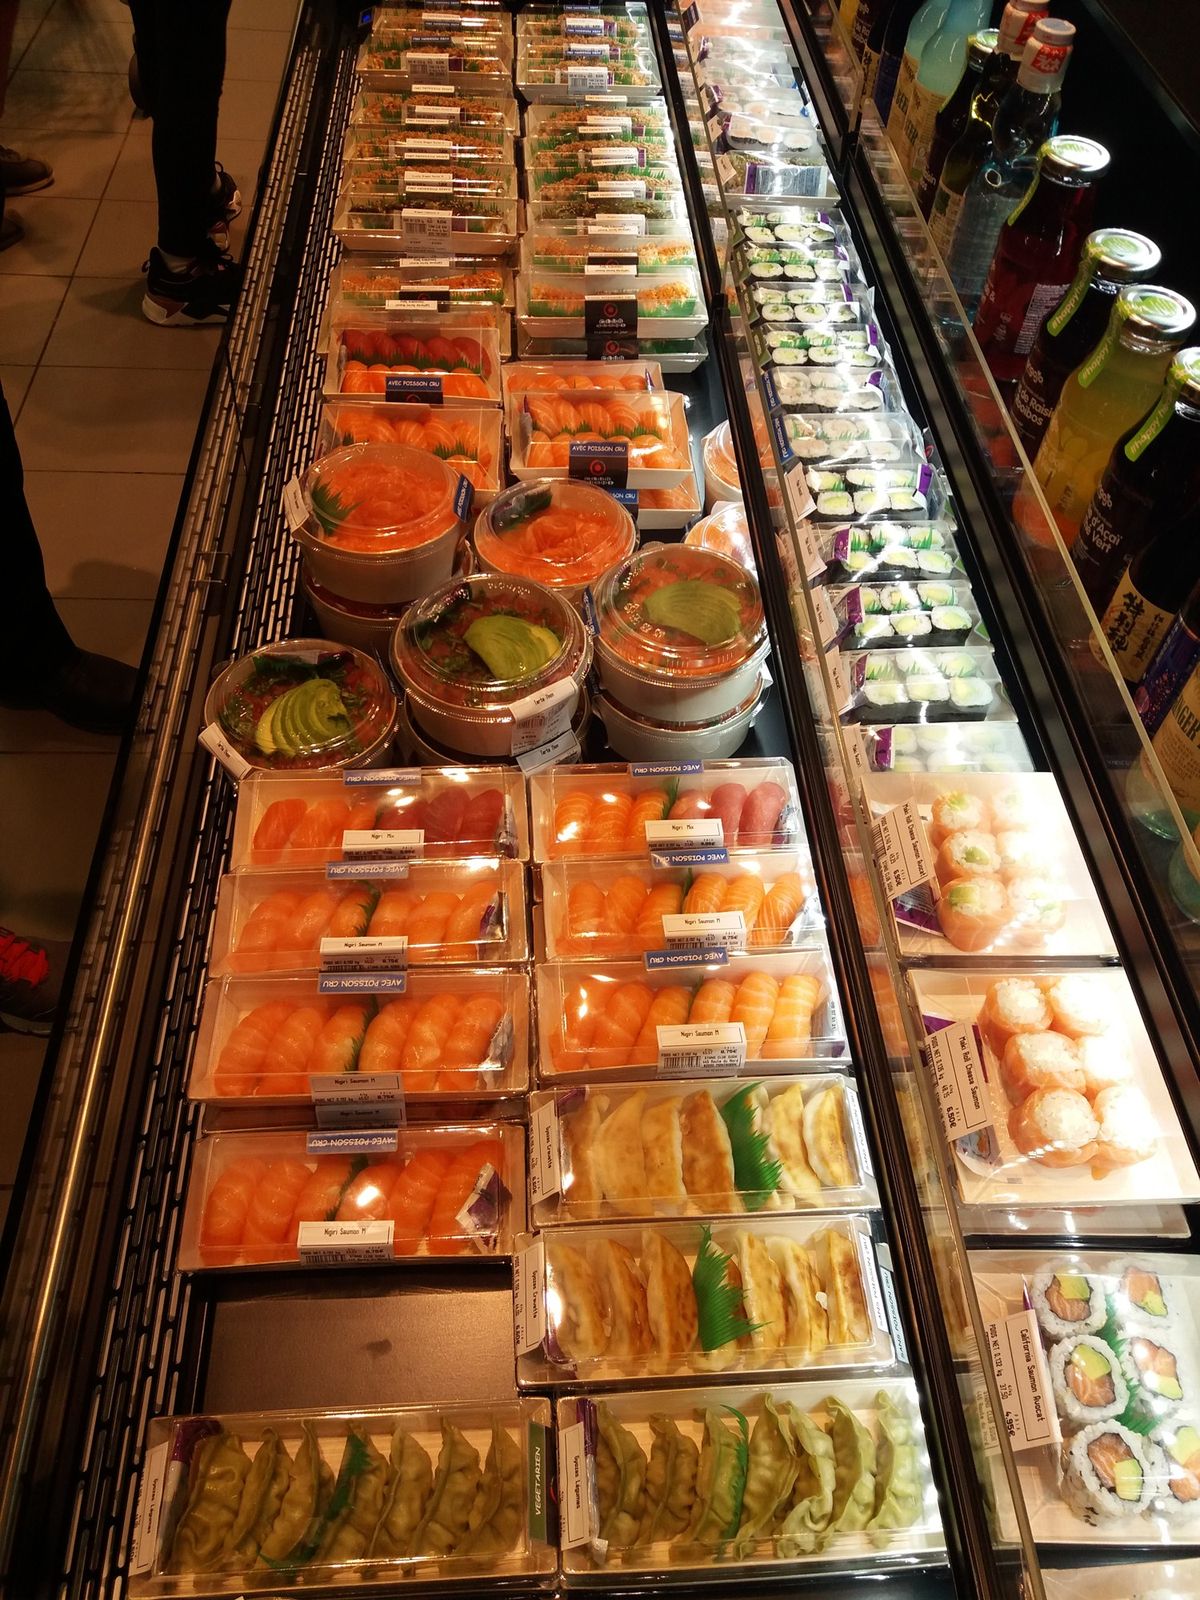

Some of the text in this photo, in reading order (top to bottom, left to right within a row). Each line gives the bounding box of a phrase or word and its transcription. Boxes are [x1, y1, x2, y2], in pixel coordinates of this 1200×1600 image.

[912, 840, 920, 859] Saumon
[666, 954, 703, 962] POISSON
[704, 952, 724, 960] AVEC
[322, 979, 402, 988] AVEC POISSON CRU
[933, 1048, 942, 1060] NET
[958, 1035, 981, 1110] Maki Roll Cheese Saumon
[339, 1227, 360, 1235] Saumon
[989, 1323, 998, 1339] POIDS
[992, 1339, 1001, 1352] NET
[996, 1369, 1003, 1378] kg
[1019, 1328, 1046, 1423] California Saumon Avocat
[1005, 1411, 1016, 1438] 4.95€
